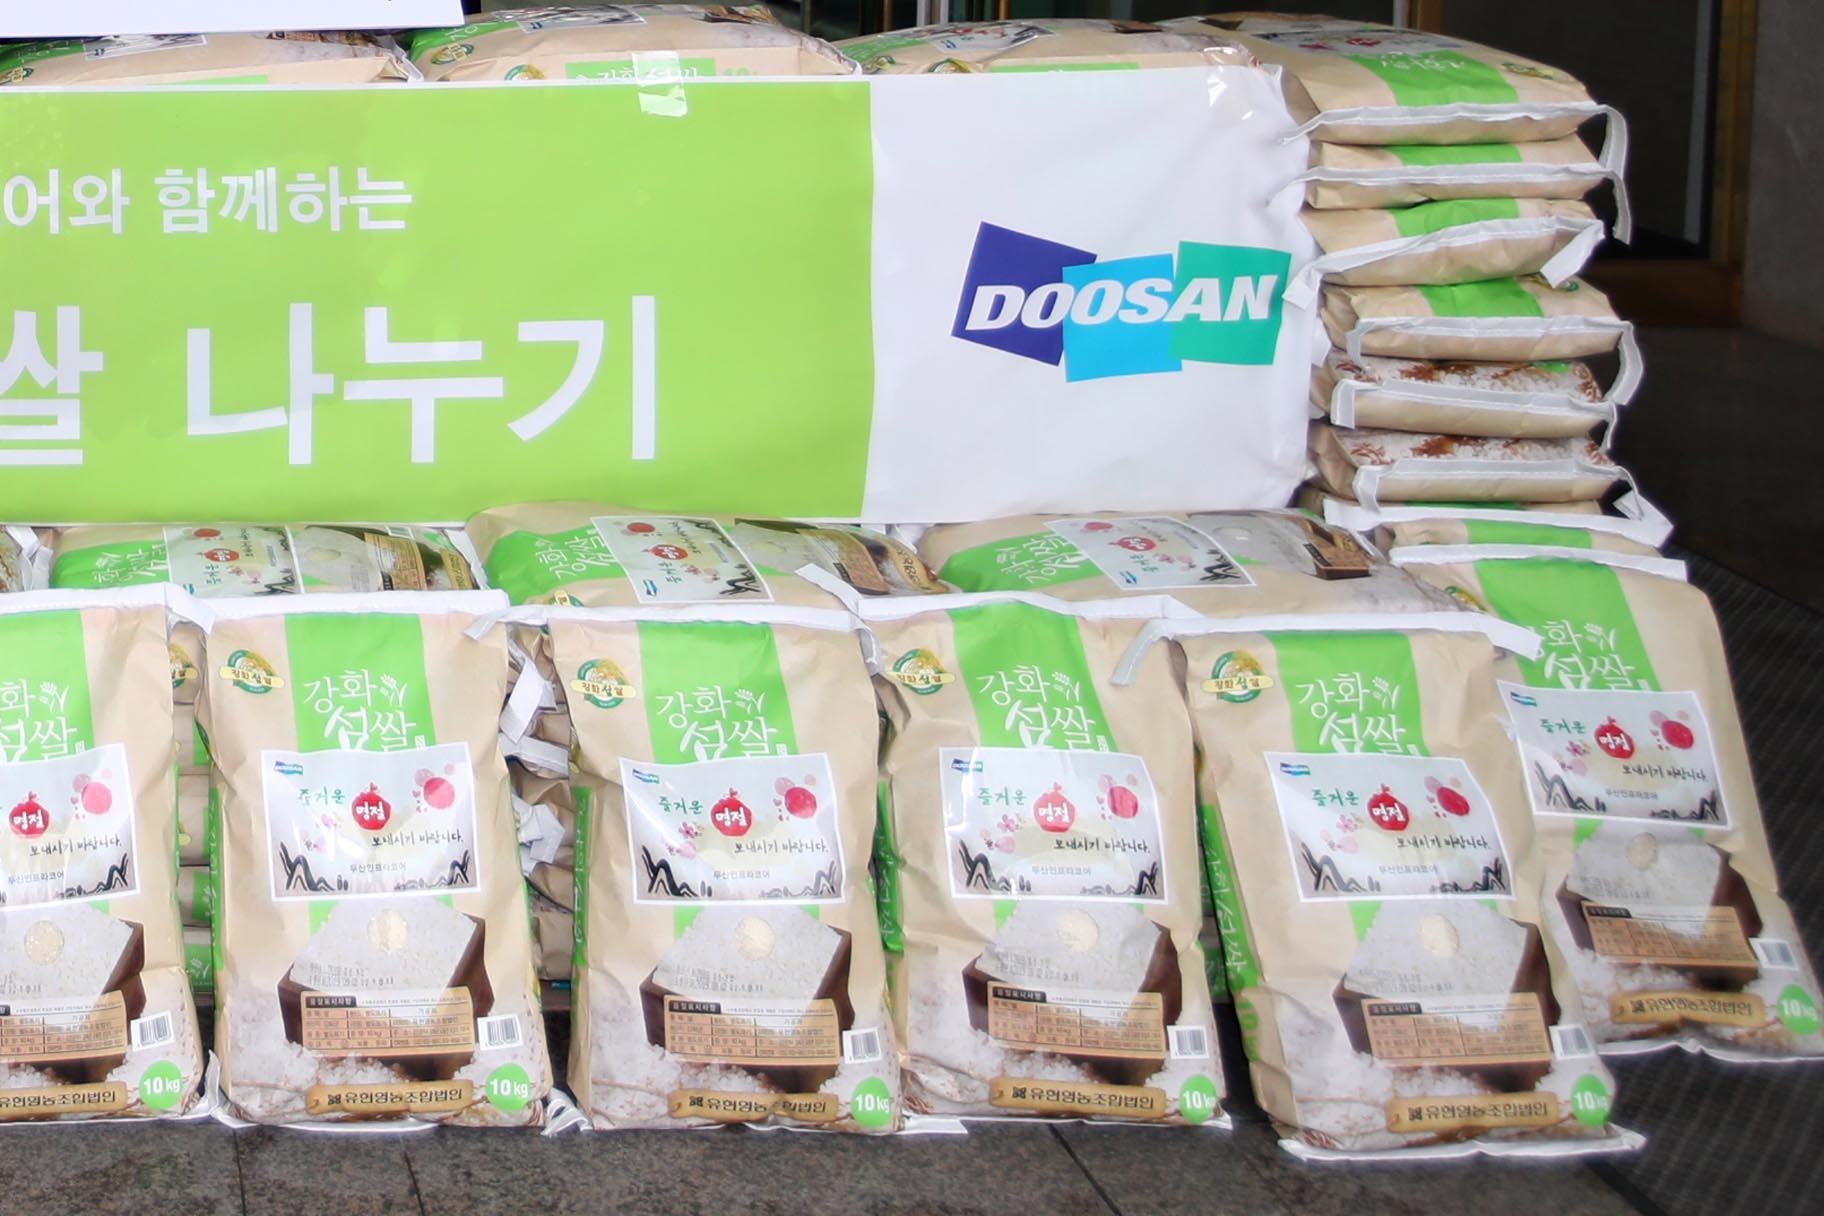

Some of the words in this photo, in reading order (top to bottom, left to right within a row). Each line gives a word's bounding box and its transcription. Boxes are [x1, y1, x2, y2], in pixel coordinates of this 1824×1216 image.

[154, 167, 413, 233] 함께하는
[965, 275, 1278, 331] DOOSAN
[187, 296, 656, 465] 나누기
[1527, 620, 1582, 657] 화
[304, 669, 378, 714] 강화
[976, 664, 1050, 707] 강화
[1296, 672, 1370, 719] 강화
[656, 685, 732, 729] 강화
[14, 808, 44, 829] 명절
[298, 786, 345, 806] 즐거운
[356, 801, 385, 821] 명절
[658, 796, 703, 815] 즐거운
[715, 807, 747, 827] 명절
[978, 787, 1027, 806] 즐거운
[1038, 803, 1070, 823] 명절
[1312, 788, 1359, 807] 즐거운
[1372, 802, 1407, 822] 명절
[30, 839, 73, 857] 보내시기
[372, 832, 415, 847] 보내시기
[734, 840, 778, 853] 보내시기
[1053, 837, 1100, 852] 보내시기
[1397, 835, 1440, 849] 보내시기
